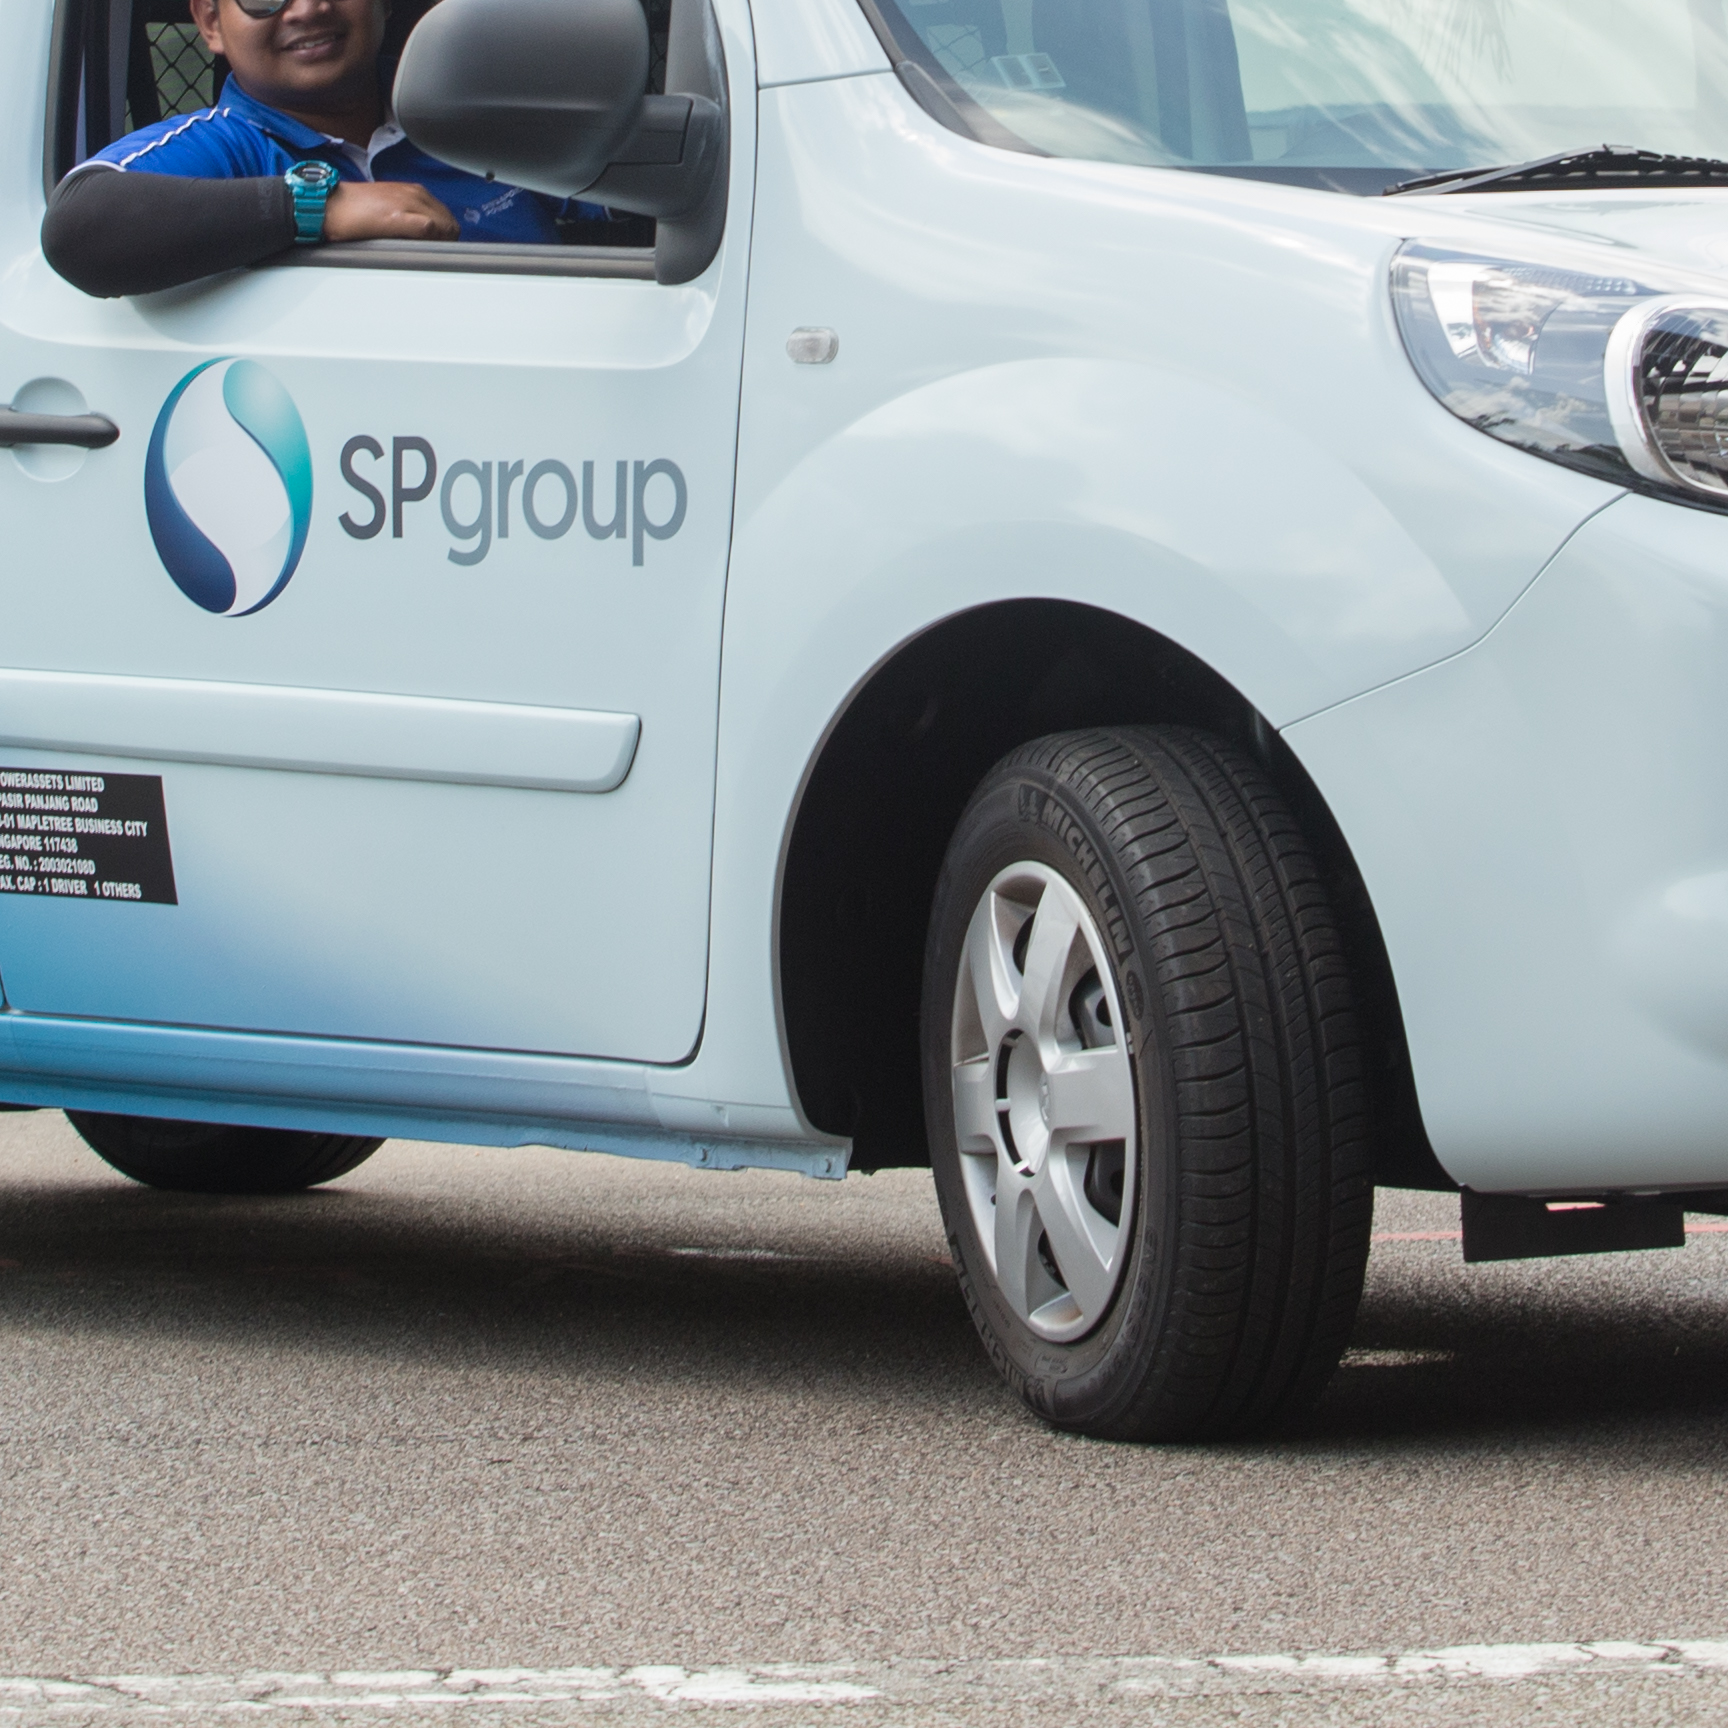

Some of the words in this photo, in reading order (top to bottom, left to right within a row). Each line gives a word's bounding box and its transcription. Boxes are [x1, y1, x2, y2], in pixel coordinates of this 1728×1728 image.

[65, 775, 105, 792] LIMITED
[25, 794, 70, 812] PANJANG
[71, 796, 99, 813] ROAD
[16, 814, 74, 833] MAPLETREE
[75, 817, 123, 836] BUSINESS
[124, 820, 148, 837] CITY
[43, 836, 78, 854] 117438
[1040, 795, 1133, 956] MICHELIN
[51, 878, 88, 896] DRIVER
[94, 880, 100, 896] 1
[101, 881, 142, 899] OTHERS
